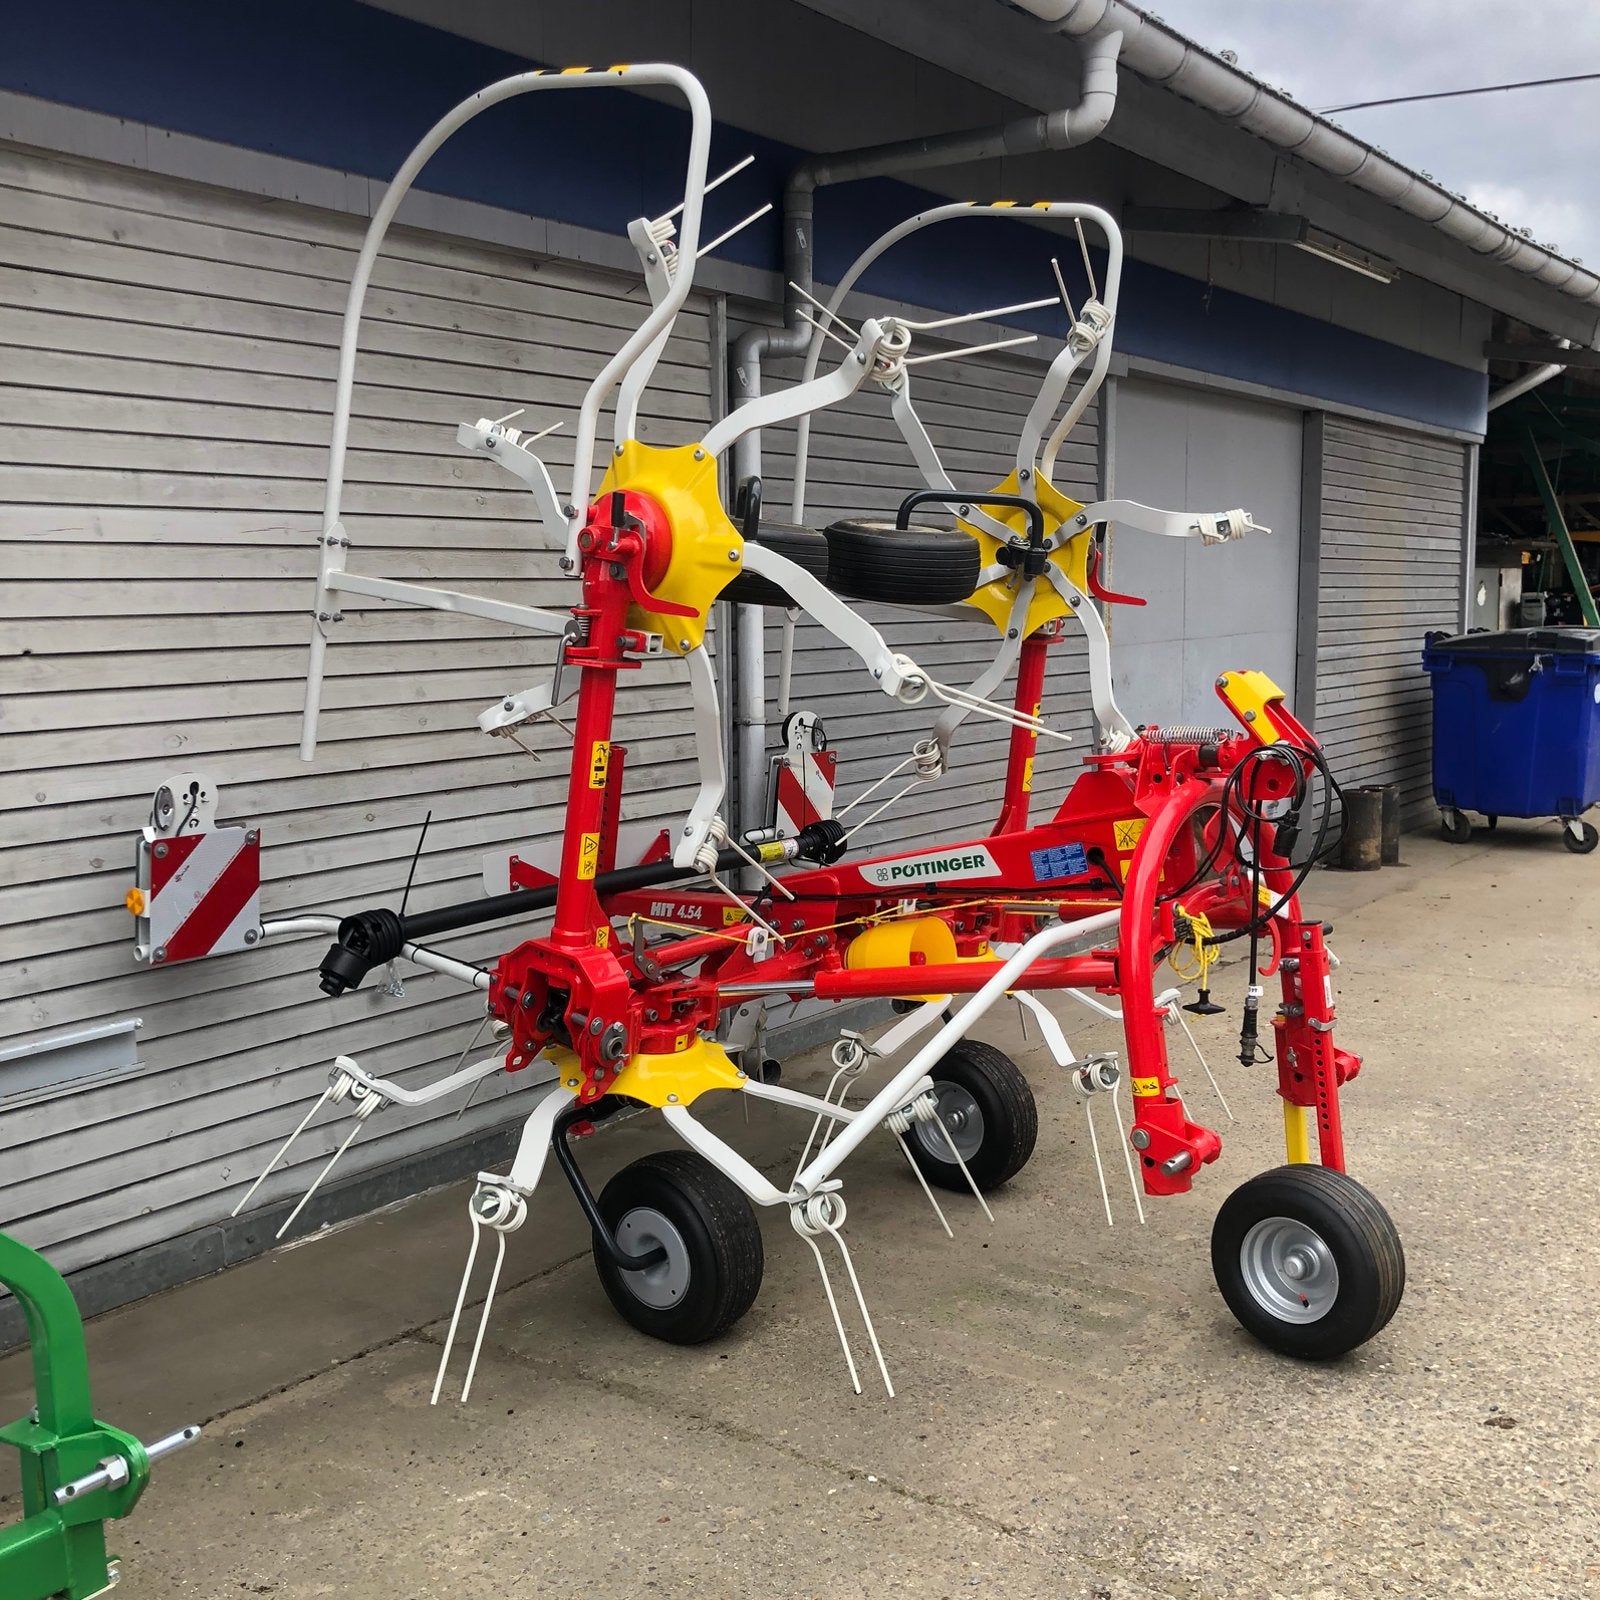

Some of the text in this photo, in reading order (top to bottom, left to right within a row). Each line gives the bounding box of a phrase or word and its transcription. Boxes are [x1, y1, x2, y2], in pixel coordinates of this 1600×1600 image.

[891, 854, 985, 880] PÖTTINGER
[650, 901, 702, 920] HIT 4.54
